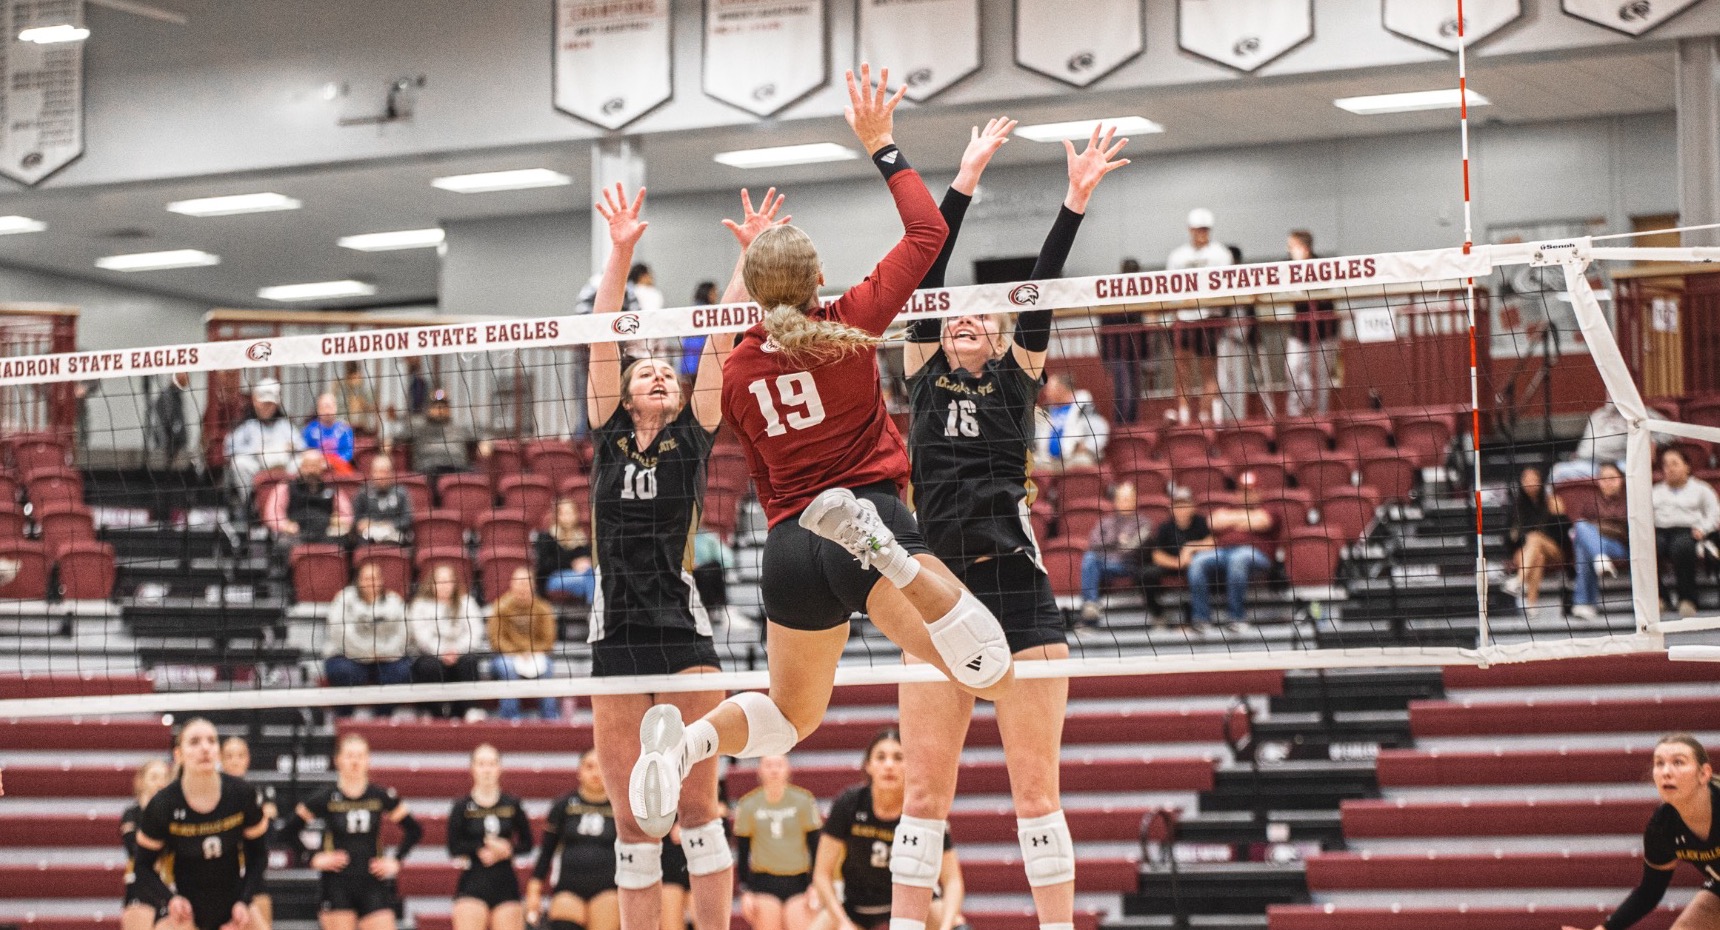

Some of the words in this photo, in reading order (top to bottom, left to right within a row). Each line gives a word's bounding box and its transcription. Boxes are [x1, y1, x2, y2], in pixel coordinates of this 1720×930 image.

[1095, 273, 1198, 299] CHADRON
[1208, 266, 1280, 291] STATE
[1289, 258, 1376, 285] EAGLES
[692, 306, 761, 329] CHADR
[900, 292, 950, 314] LES
[322, 332, 410, 356] CHADRON
[418, 327, 477, 348] STATE
[486, 320, 560, 343] EAGLES
[0, 358, 60, 378] ADRON
[68, 353, 123, 373] STATE
[131, 348, 199, 369] EAGLES
[748, 371, 826, 438] 19
[944, 399, 980, 437] 16
[621, 463, 658, 500] 10
